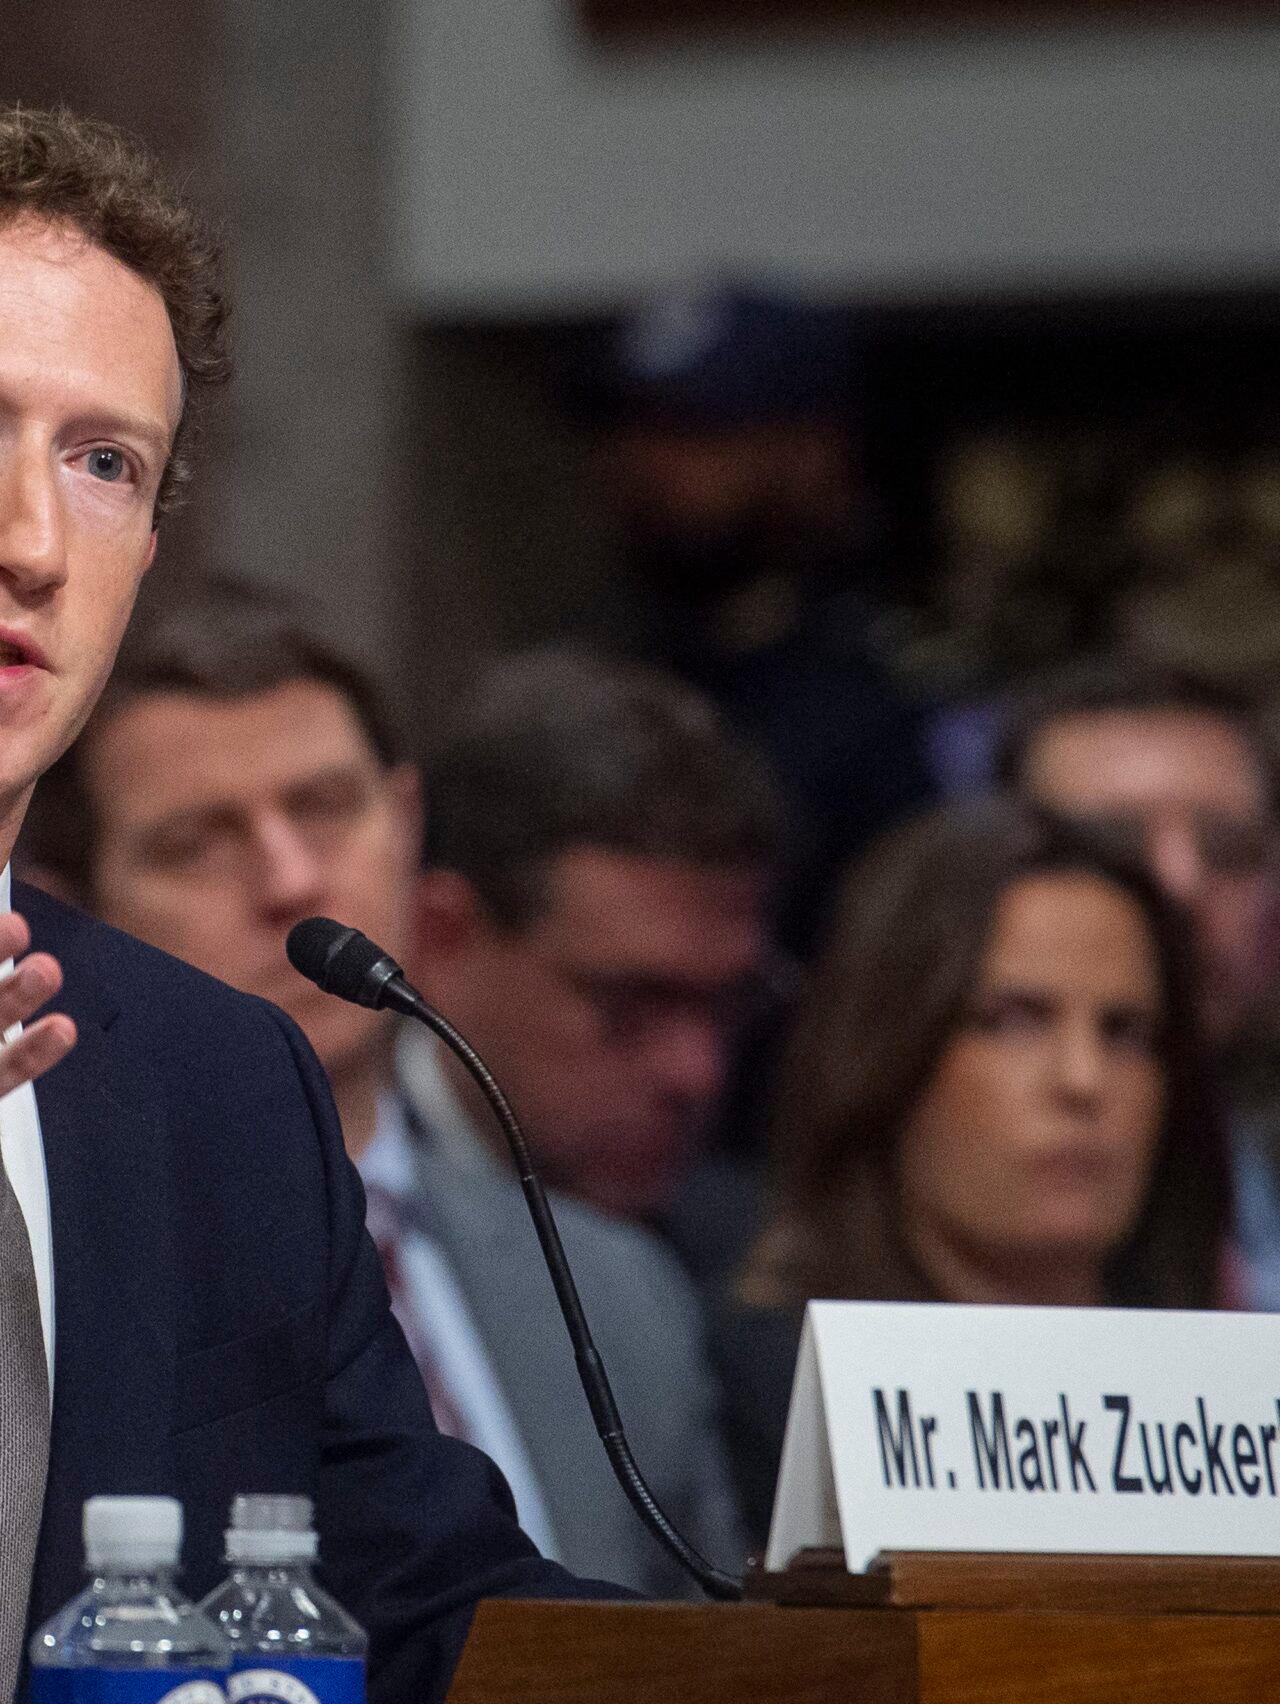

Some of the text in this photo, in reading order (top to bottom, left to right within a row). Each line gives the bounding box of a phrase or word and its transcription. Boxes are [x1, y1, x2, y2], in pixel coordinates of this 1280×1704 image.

[872, 1388, 1280, 1497] Mr. Mark Zucker
